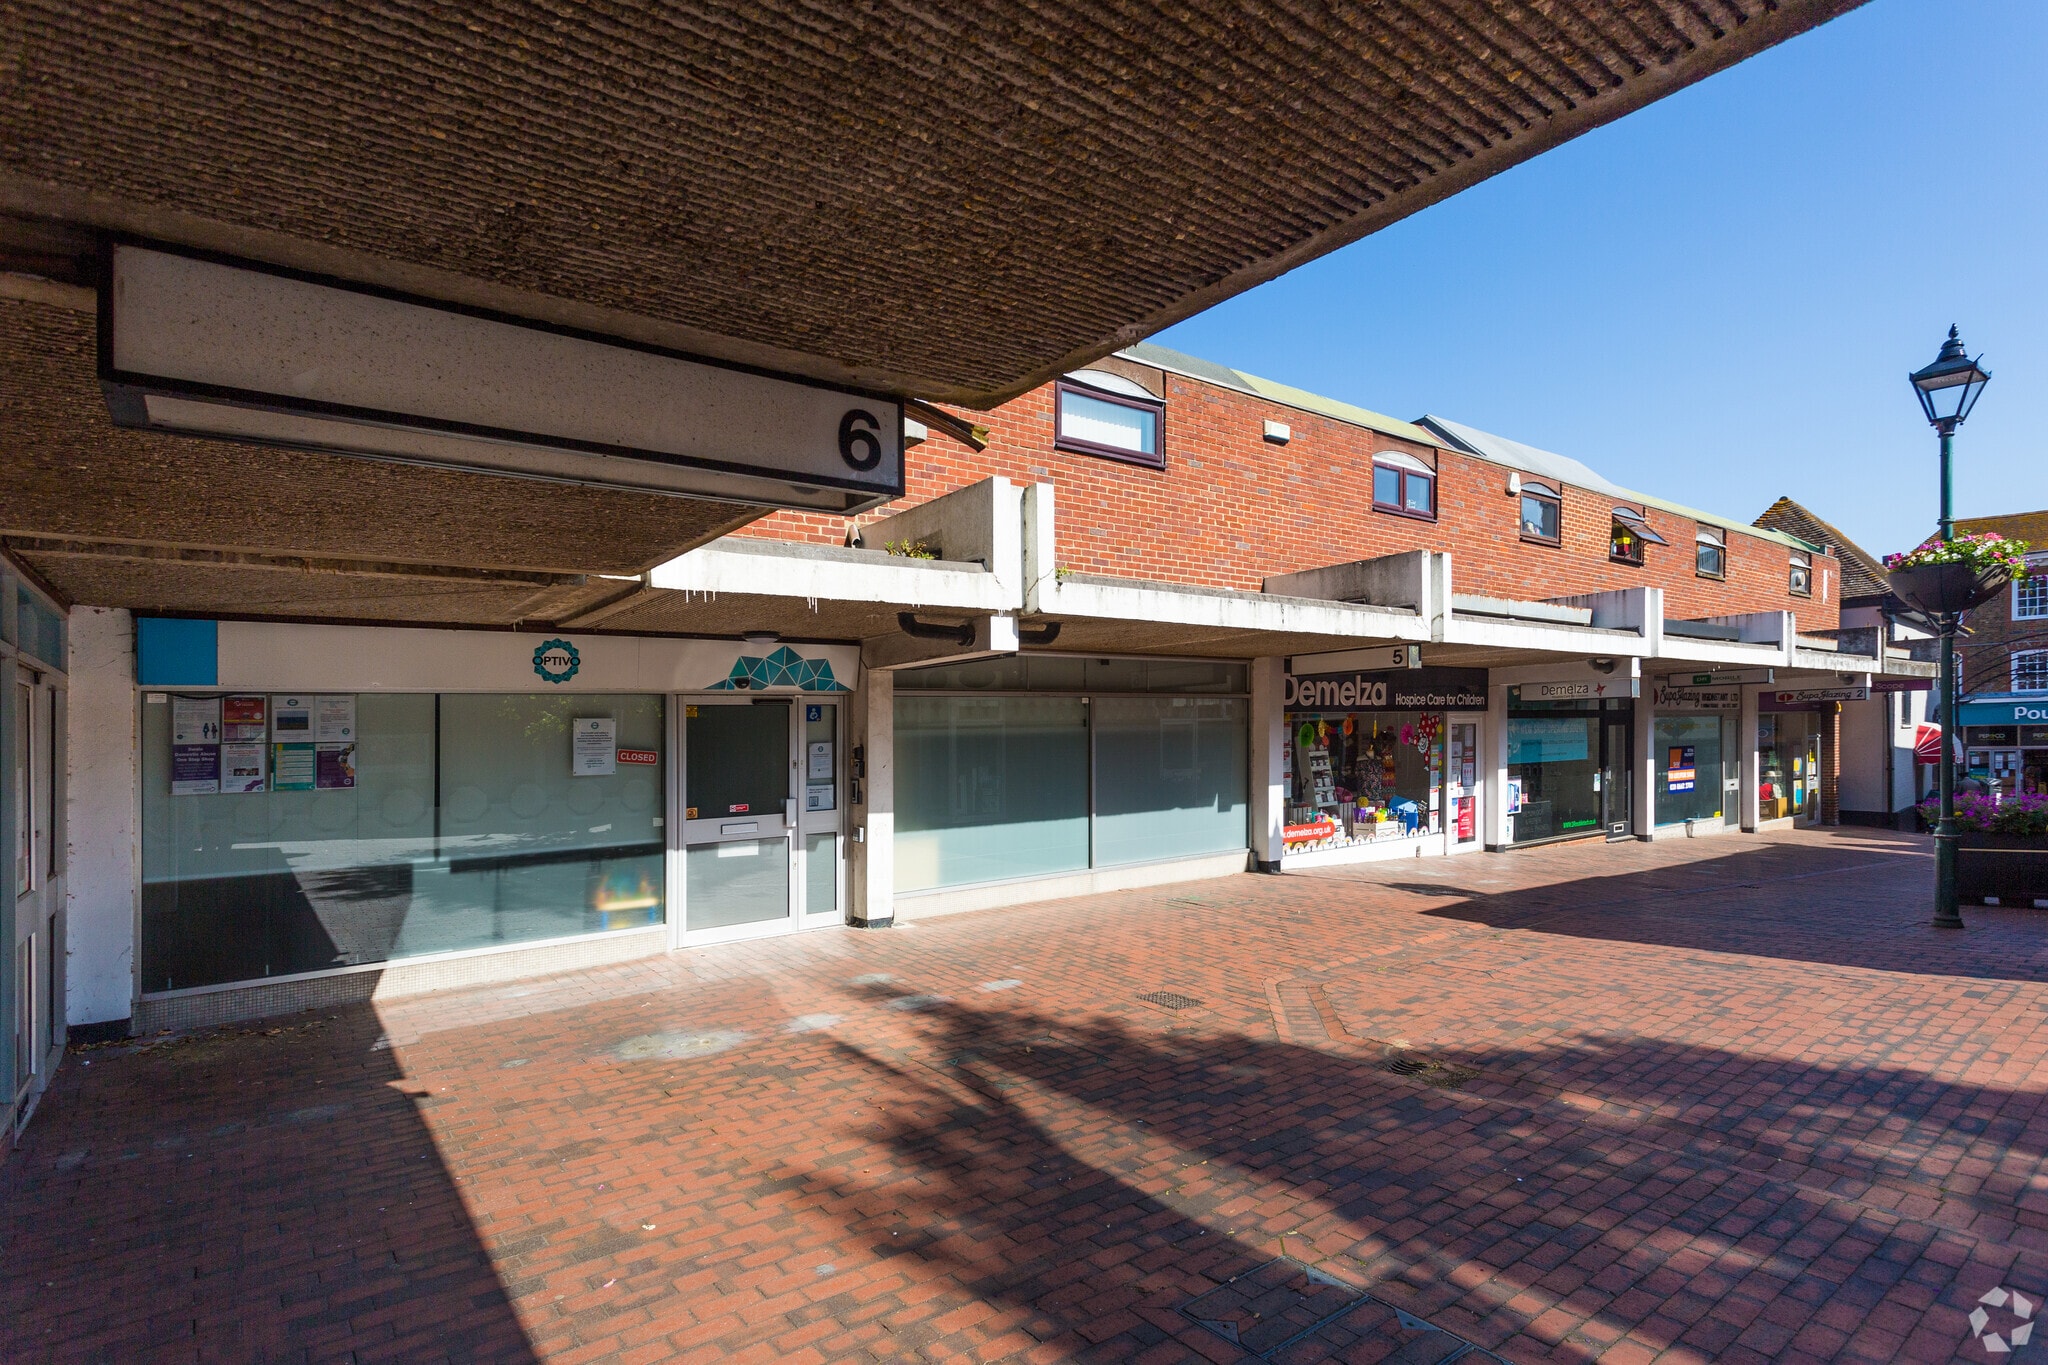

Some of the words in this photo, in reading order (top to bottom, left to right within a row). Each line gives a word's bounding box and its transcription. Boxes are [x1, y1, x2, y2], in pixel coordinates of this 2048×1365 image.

[838, 408, 882, 472] 6
[532, 656, 581, 666] OPTIVO
[1392, 649, 1404, 664] 5
[1284, 673, 1386, 706] Demelza
[1541, 684, 1589, 696] Demelza
[1856, 689, 1864, 698] 2
[1395, 693, 1426, 708] Hospice
[1427, 694, 1445, 706] Care
[1446, 693, 1456, 705] for
[1457, 692, 1485, 706] Children
[620, 752, 655, 762] CLOSED
